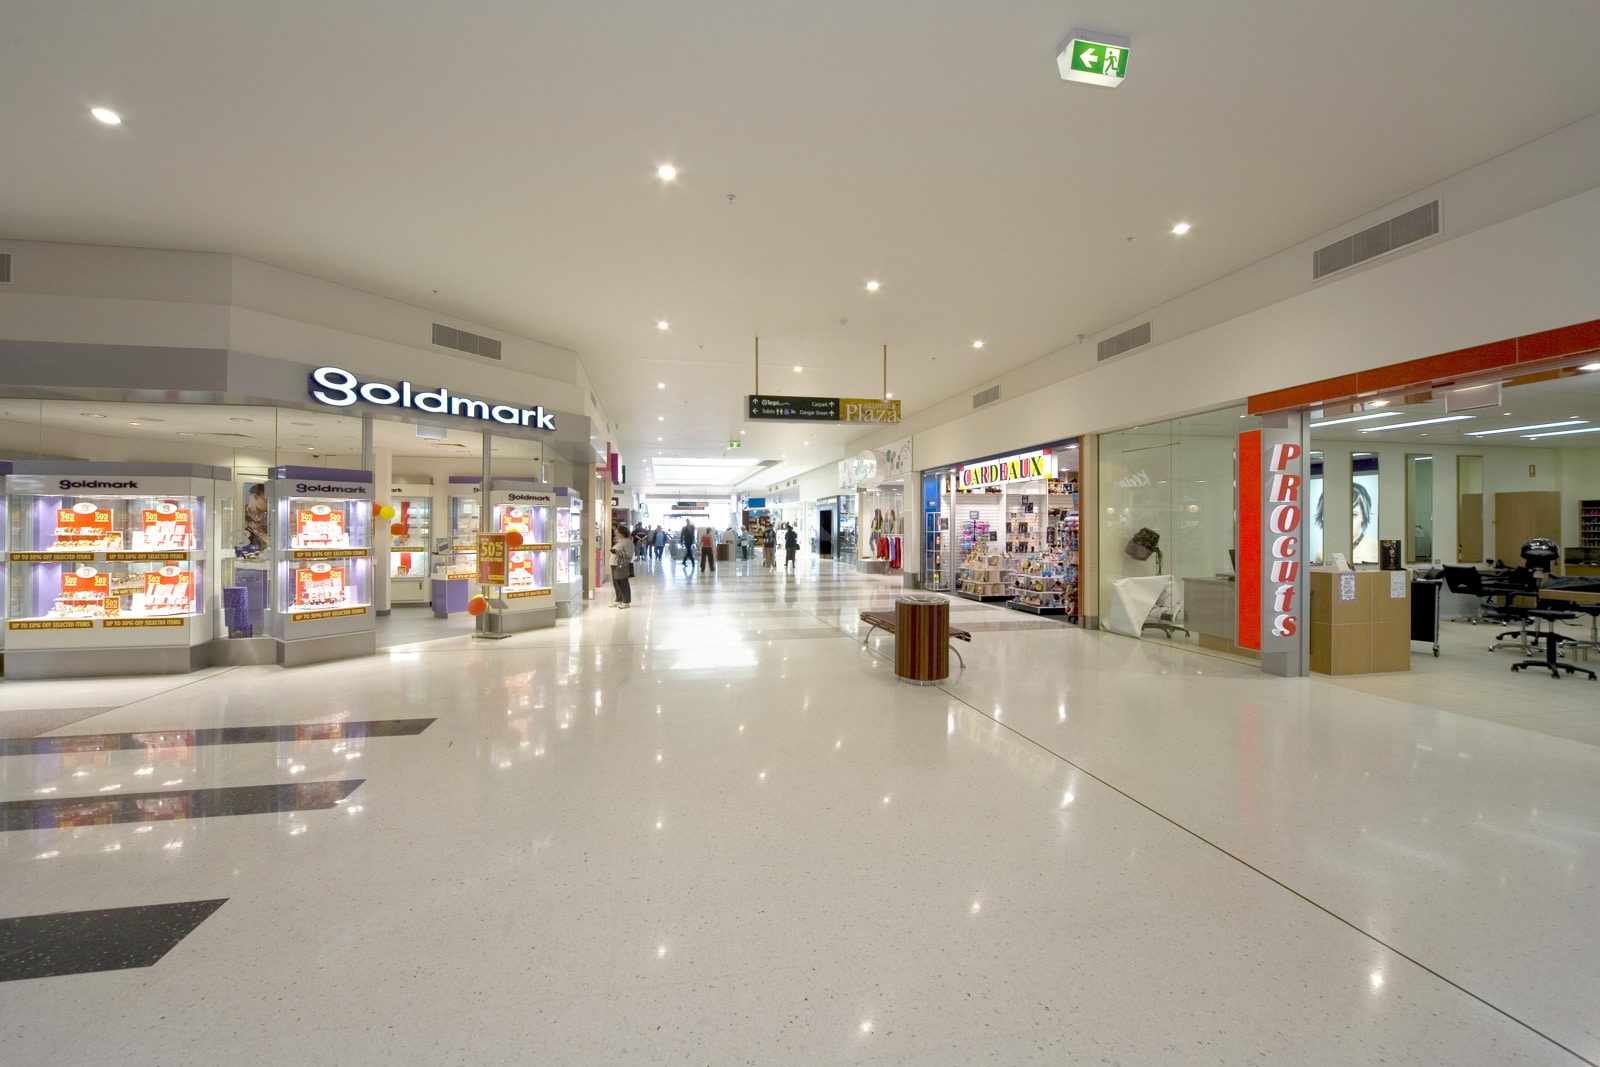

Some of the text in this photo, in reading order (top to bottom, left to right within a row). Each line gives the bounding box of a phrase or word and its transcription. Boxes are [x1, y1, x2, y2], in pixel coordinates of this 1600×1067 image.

[846, 403, 897, 422] Plaza
[964, 456, 1043, 486] CARDEAUX
[481, 542, 503, 556] 50%
